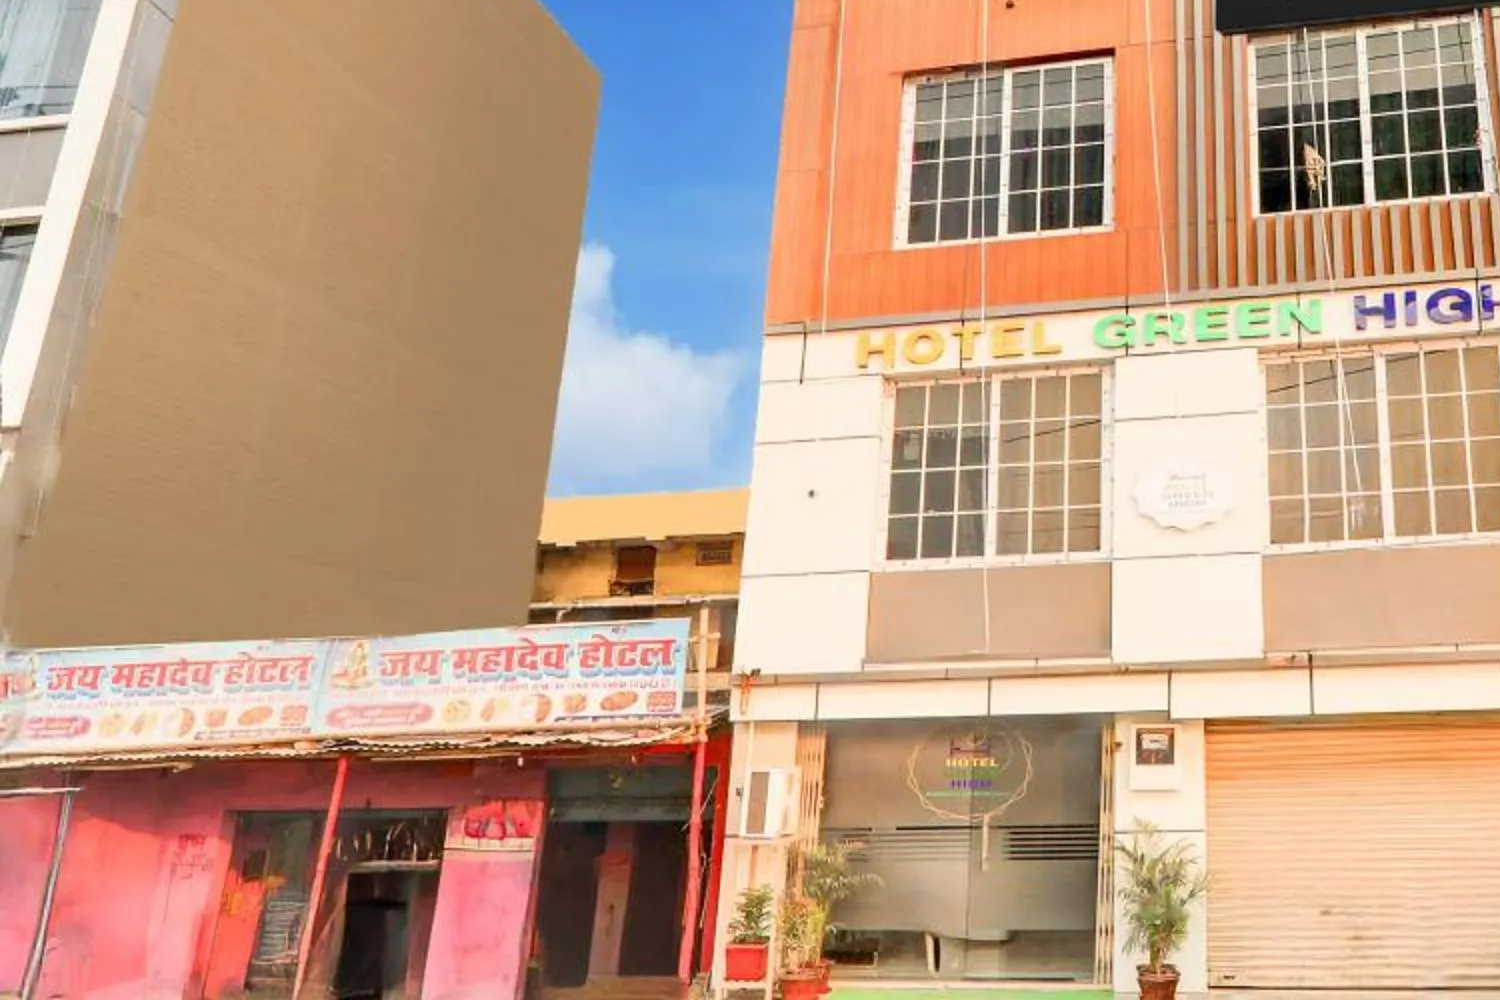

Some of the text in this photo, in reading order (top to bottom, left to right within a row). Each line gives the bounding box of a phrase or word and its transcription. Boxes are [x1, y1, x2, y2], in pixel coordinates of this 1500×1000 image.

[854, 319, 1063, 370] HOTEL
[1092, 298, 1322, 350] GREEN
[47, 665, 105, 692] जय
[111, 657, 219, 688] महादेव
[223, 652, 316, 685] होटल
[379, 633, 677, 680] जय महादेव होटल
